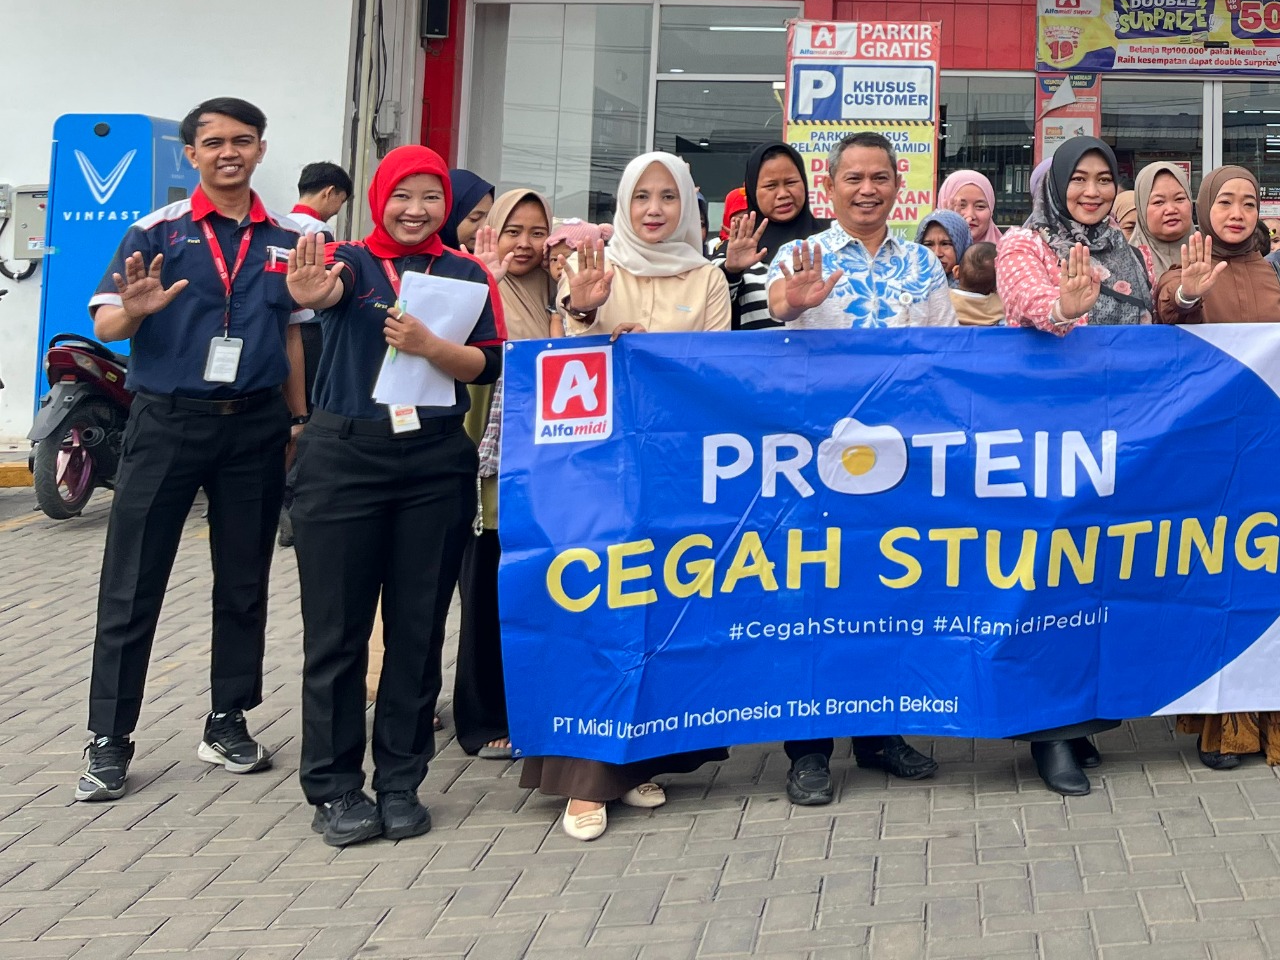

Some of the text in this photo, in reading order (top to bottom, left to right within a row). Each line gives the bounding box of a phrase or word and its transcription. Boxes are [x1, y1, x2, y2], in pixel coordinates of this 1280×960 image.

[1119, 8, 1207, 34] SURPRIZE
[860, 24, 932, 40] PARKIR
[860, 42, 932, 58] GRATIS
[1130, 46, 1160, 54] Belanja
[1138, 57, 1187, 65] kesempatan
[1189, 58, 1213, 66] dapat
[1214, 58, 1242, 66] double
[1244, 58, 1277, 68] Surprize
[798, 70, 836, 114] P
[854, 81, 916, 93] KHUSUS
[844, 94, 928, 105] CUSTOMER
[63, 210, 141, 221] VINFAST
[541, 420, 608, 438] Alfamidi
[702, 418, 1117, 504] PROTEIN
[546, 511, 1280, 614] CEGAH STUNTING
[729, 606, 1109, 641] #CegahStunting #AlfamidiPeduli
[553, 696, 959, 739] PT Midi Utama Indonesia Tbk Branch Bekasi
